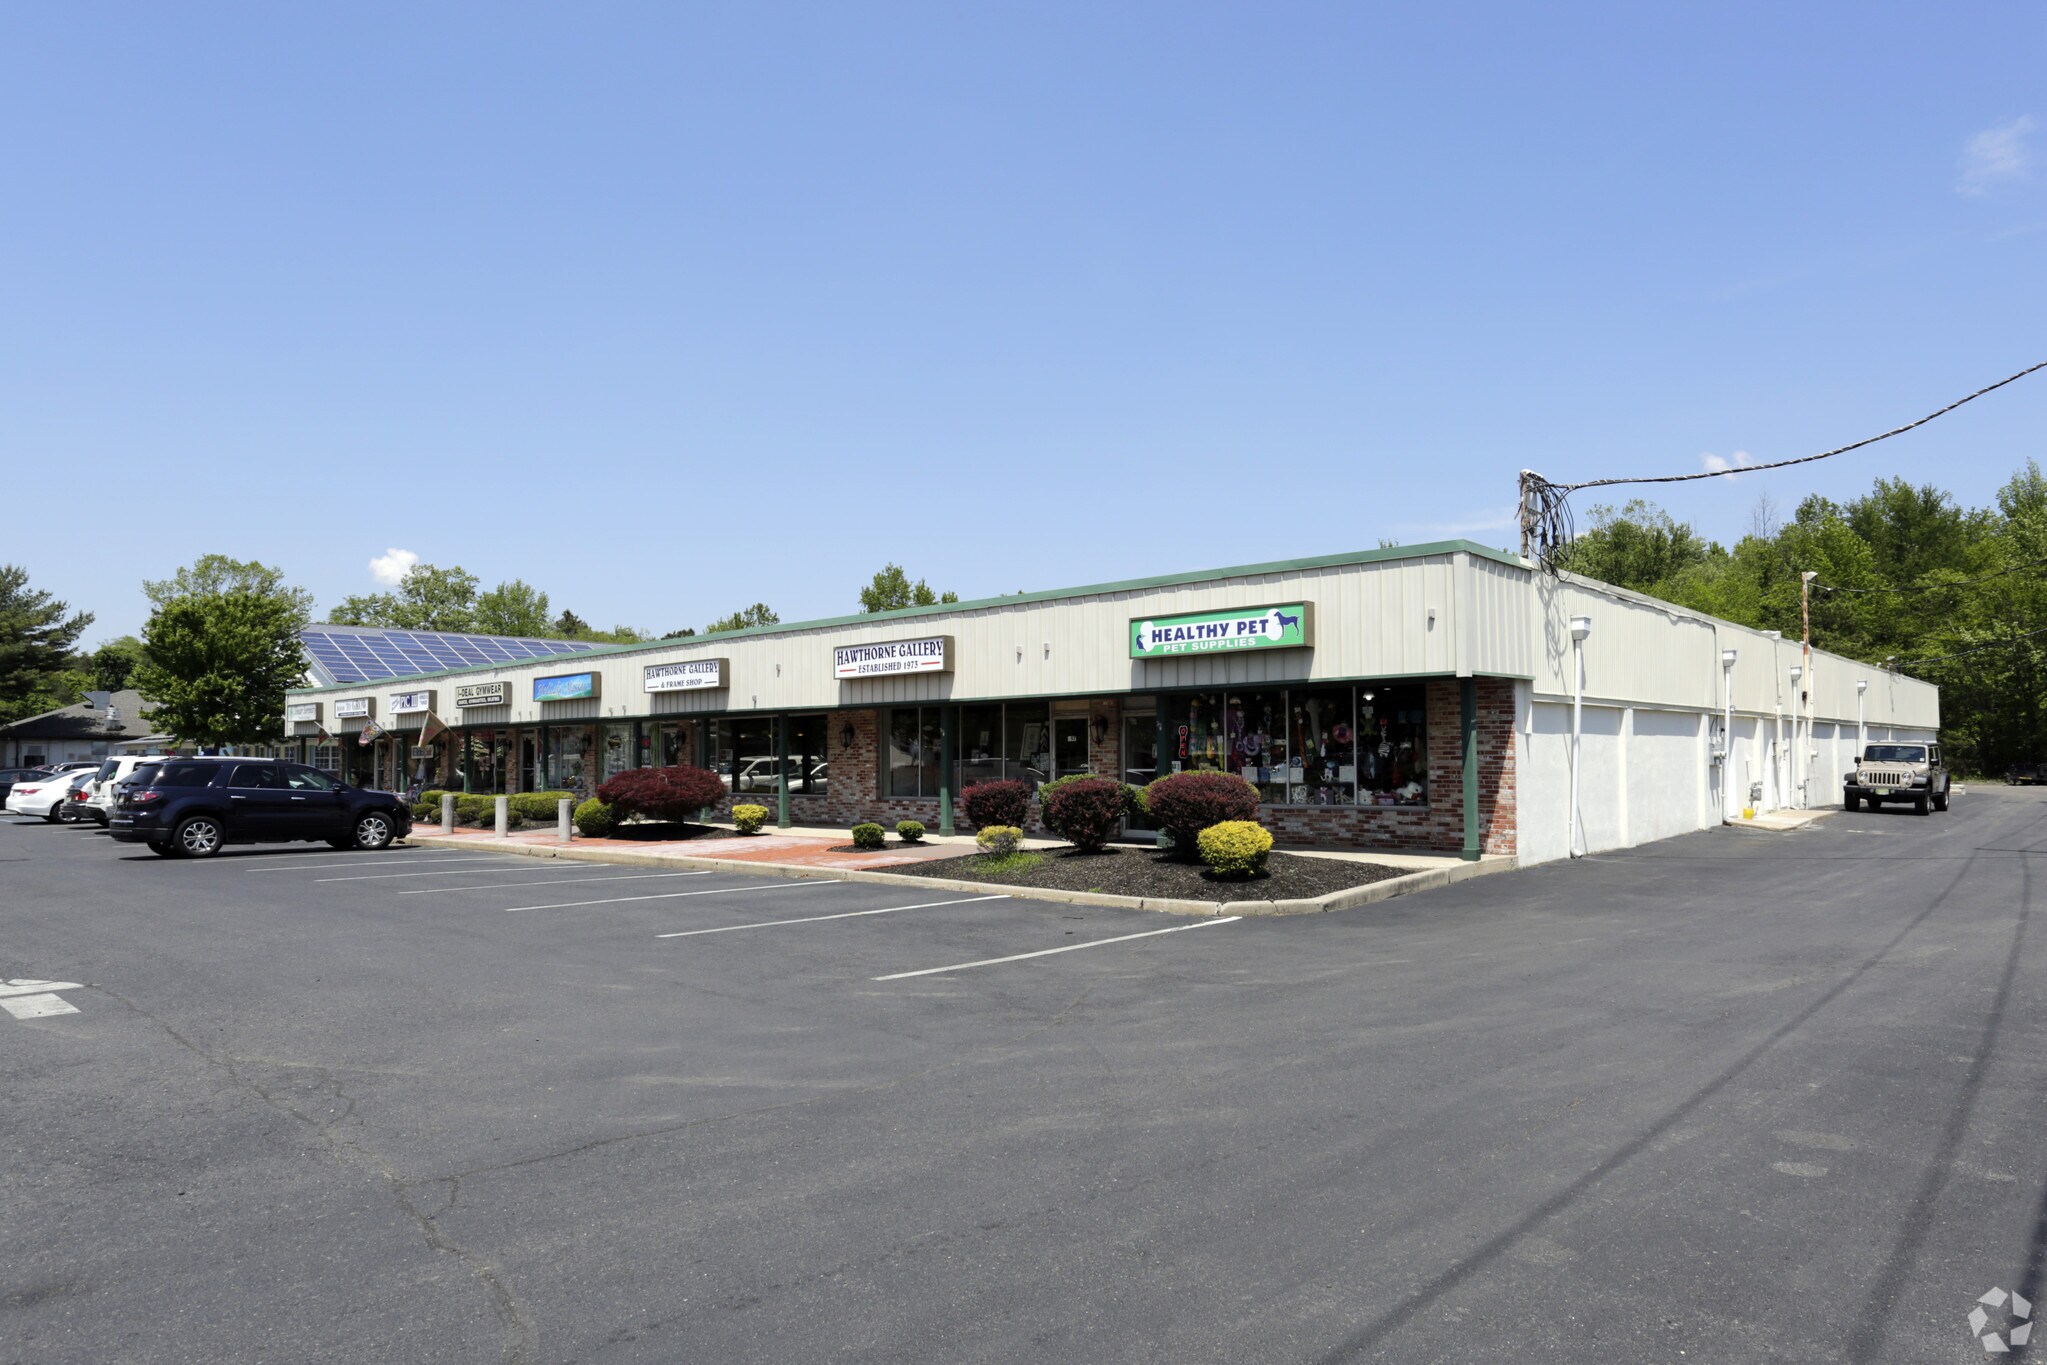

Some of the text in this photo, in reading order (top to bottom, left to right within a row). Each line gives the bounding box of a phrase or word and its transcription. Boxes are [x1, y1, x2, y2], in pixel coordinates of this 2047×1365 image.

[1152, 619, 1269, 643] HEALTHY PET
[1163, 638, 1256, 653] PET SUPPLIES
[837, 641, 943, 666] HAWTHORNE GALLERY
[646, 662, 719, 679] HAWTHORNE GALLERY
[858, 660, 919, 673] ESTABLISHED 1973
[476, 684, 502, 696] GYMWEAR
[666, 680, 685, 688] FRAME
[686, 678, 703, 686] SHOP
